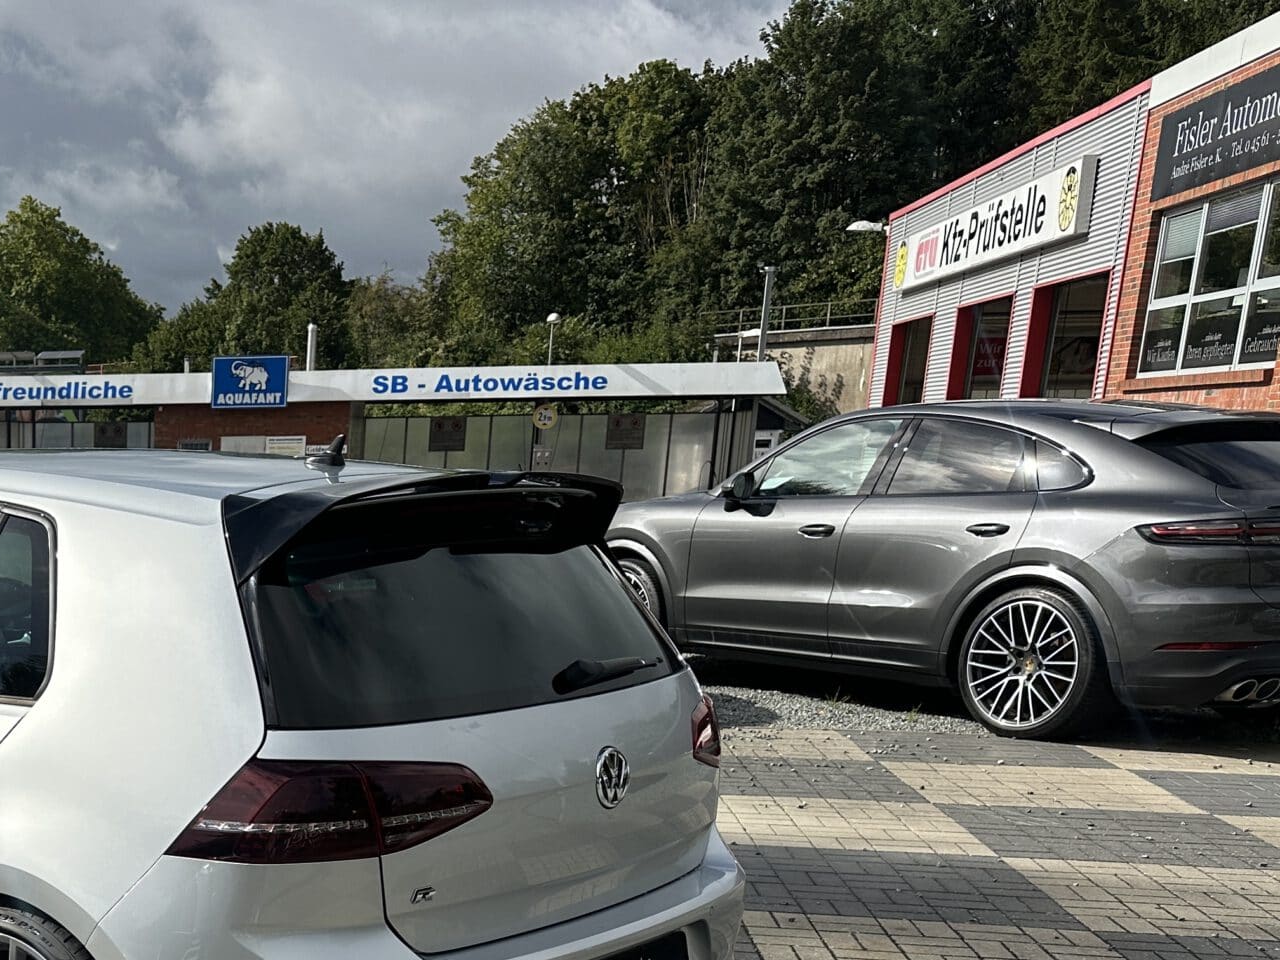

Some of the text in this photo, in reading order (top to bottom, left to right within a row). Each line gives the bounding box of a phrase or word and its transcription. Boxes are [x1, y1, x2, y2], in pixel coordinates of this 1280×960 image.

[1172, 91, 1280, 157] Fisler Autom
[1190, 153, 1207, 173] Fisler
[1231, 138, 1243, 158] Tel.
[1250, 136, 1261, 153] 45
[1261, 130, 1270, 147] 61
[939, 184, 1046, 267] Kfz-Prüfstelle
[979, 343, 1003, 354] Wir
[1244, 334, 1278, 353] Gebrauch
[372, 375, 409, 394] SB
[434, 371, 609, 393] Autowäsche
[216, 392, 282, 404] AQUAFANT
